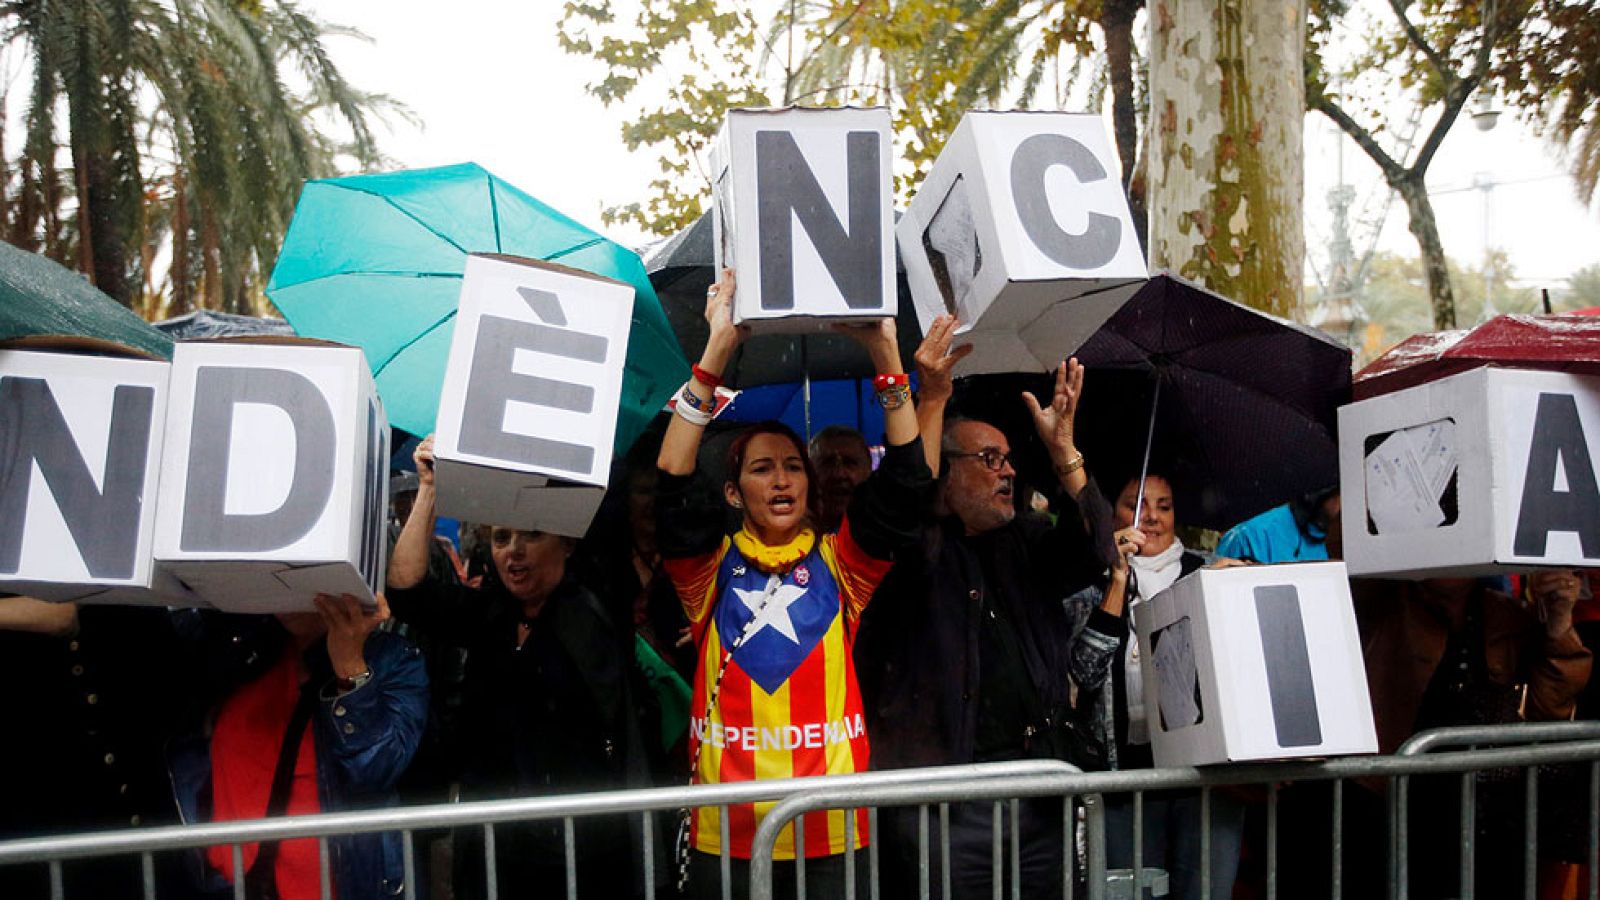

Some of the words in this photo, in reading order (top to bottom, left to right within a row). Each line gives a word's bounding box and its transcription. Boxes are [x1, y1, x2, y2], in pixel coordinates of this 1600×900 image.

[756, 130, 884, 311] N
[1010, 133, 1122, 270] C
[180, 365, 337, 553] D
[457, 285, 609, 475] È
[0, 375, 155, 580] N
[1513, 392, 1600, 559] A
[1253, 584, 1323, 747] I
